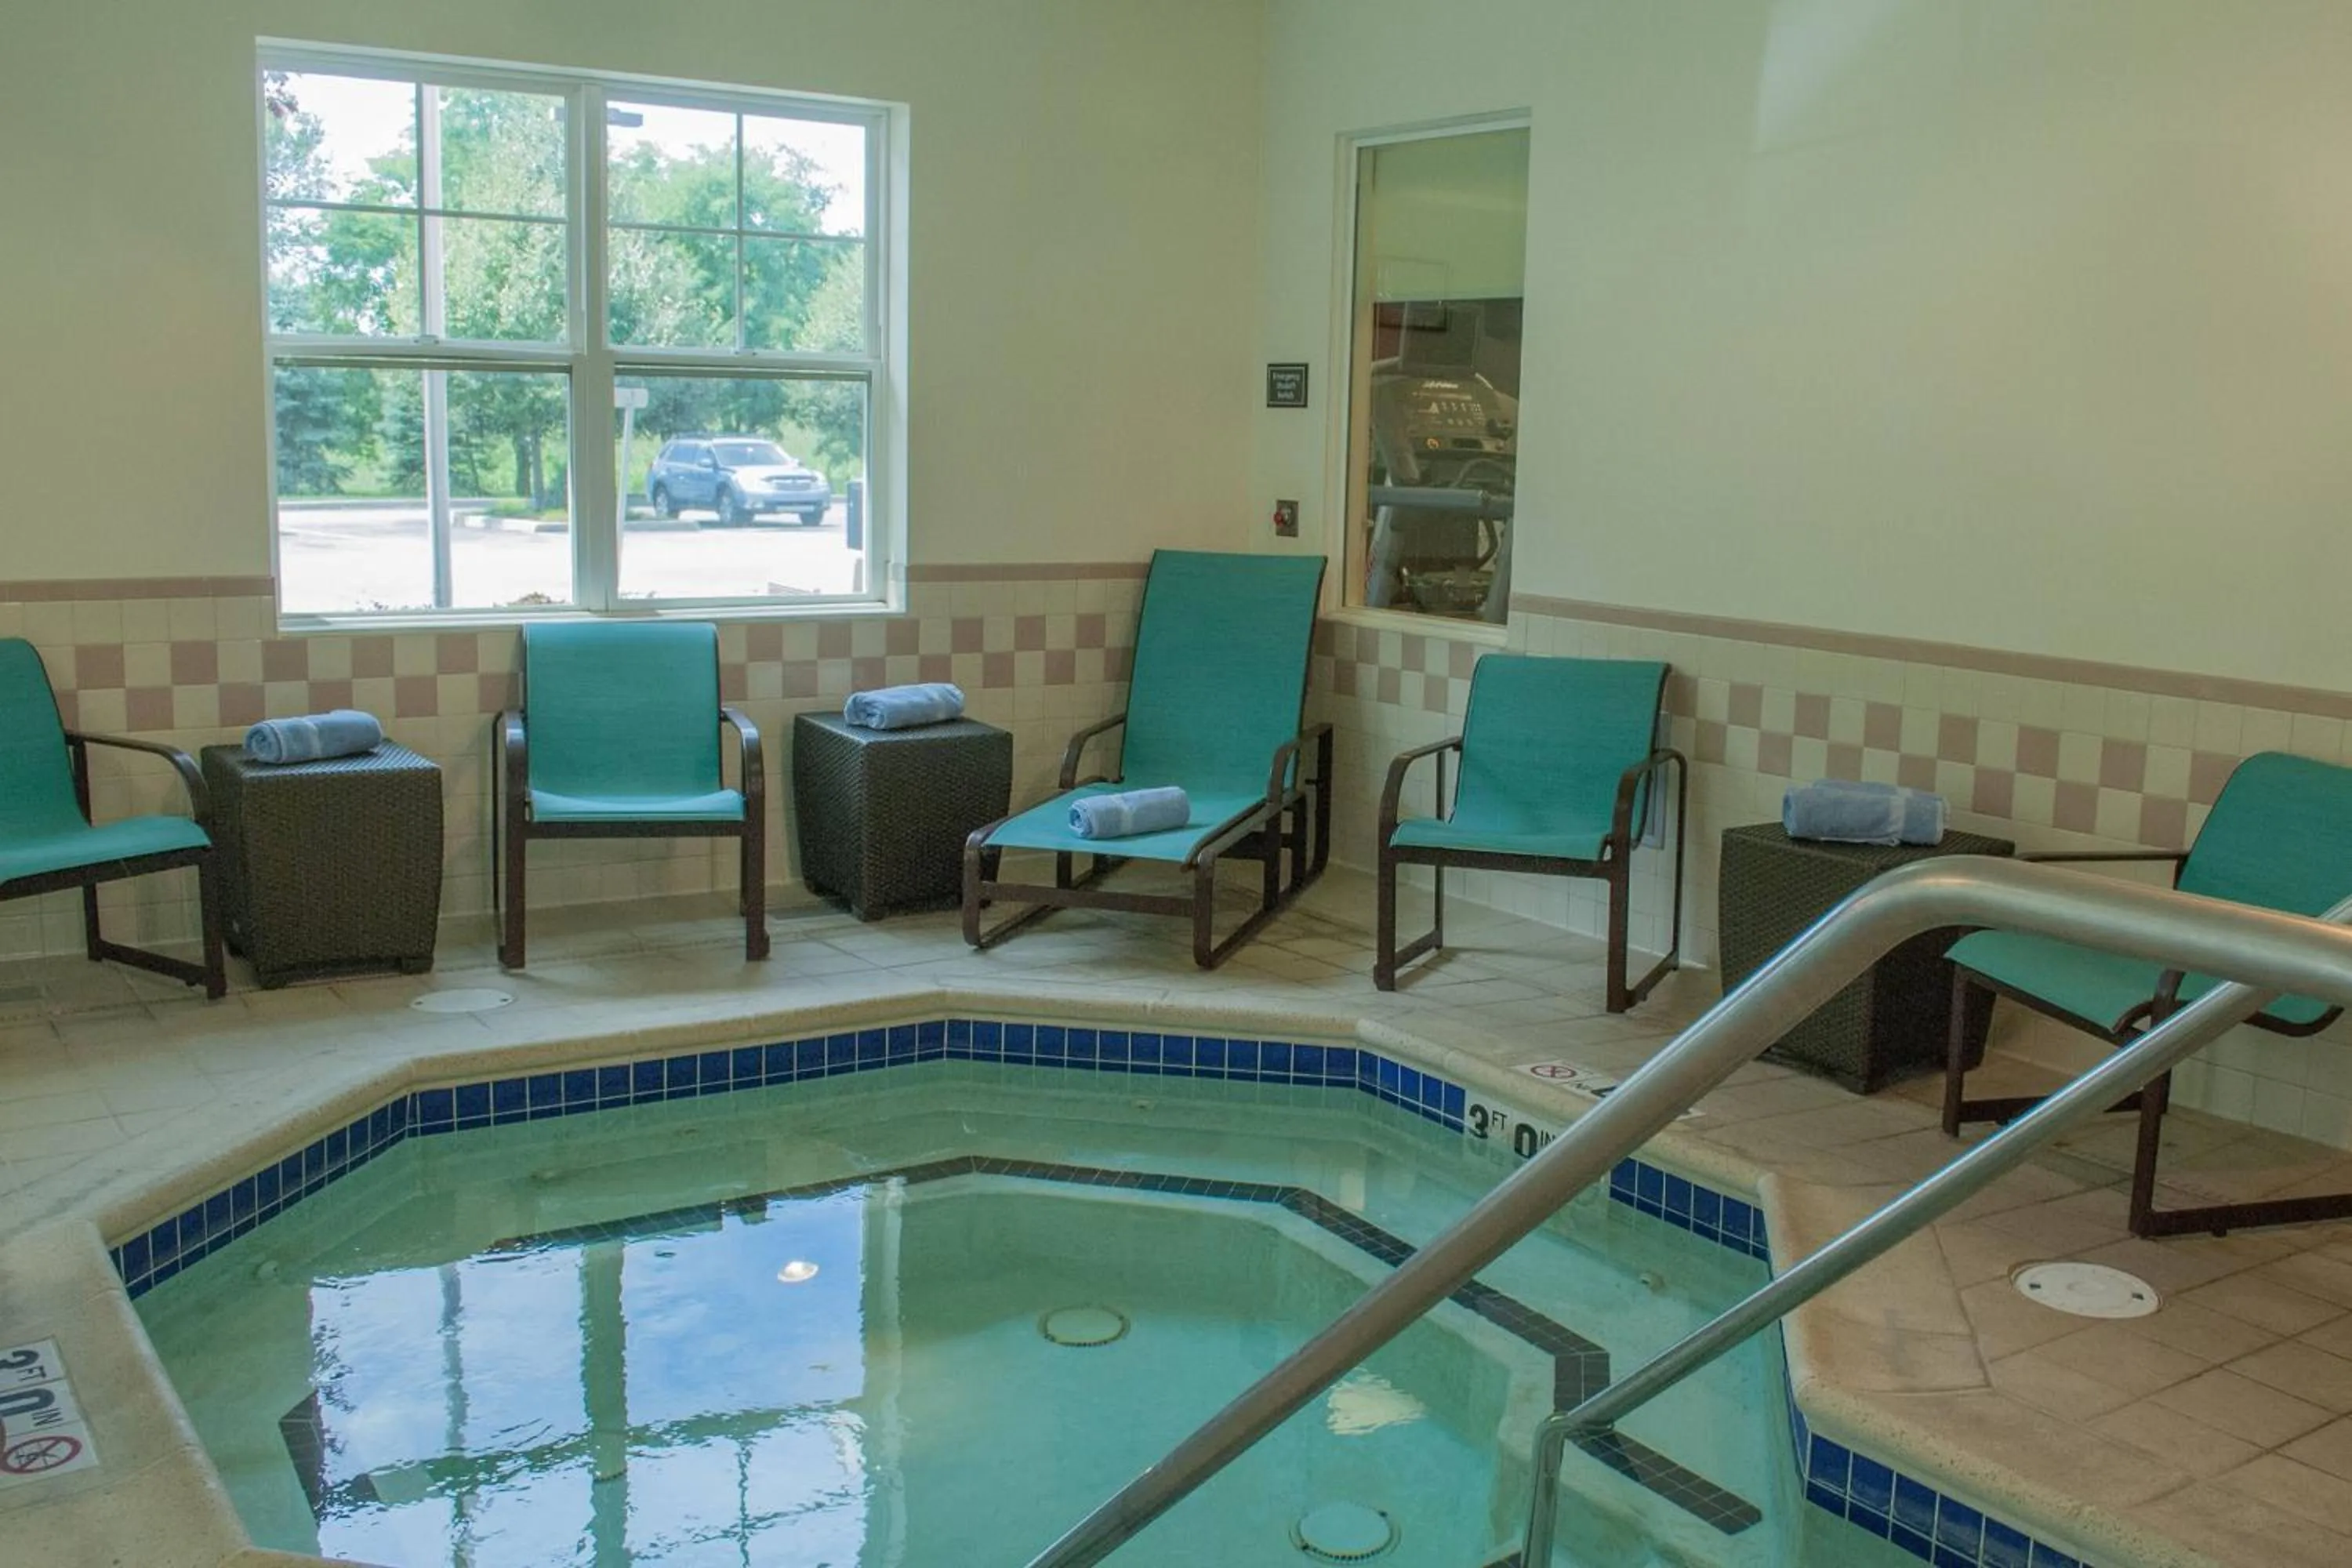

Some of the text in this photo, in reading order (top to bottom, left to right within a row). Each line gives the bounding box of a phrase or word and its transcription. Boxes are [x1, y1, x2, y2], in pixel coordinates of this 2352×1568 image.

[1468, 1103, 1489, 1139] 3
[1492, 1110, 1508, 1130] FT
[1514, 1123, 1537, 1159] 0
[16, 1365, 47, 1382] FT
[31, 1407, 64, 1427] IN
